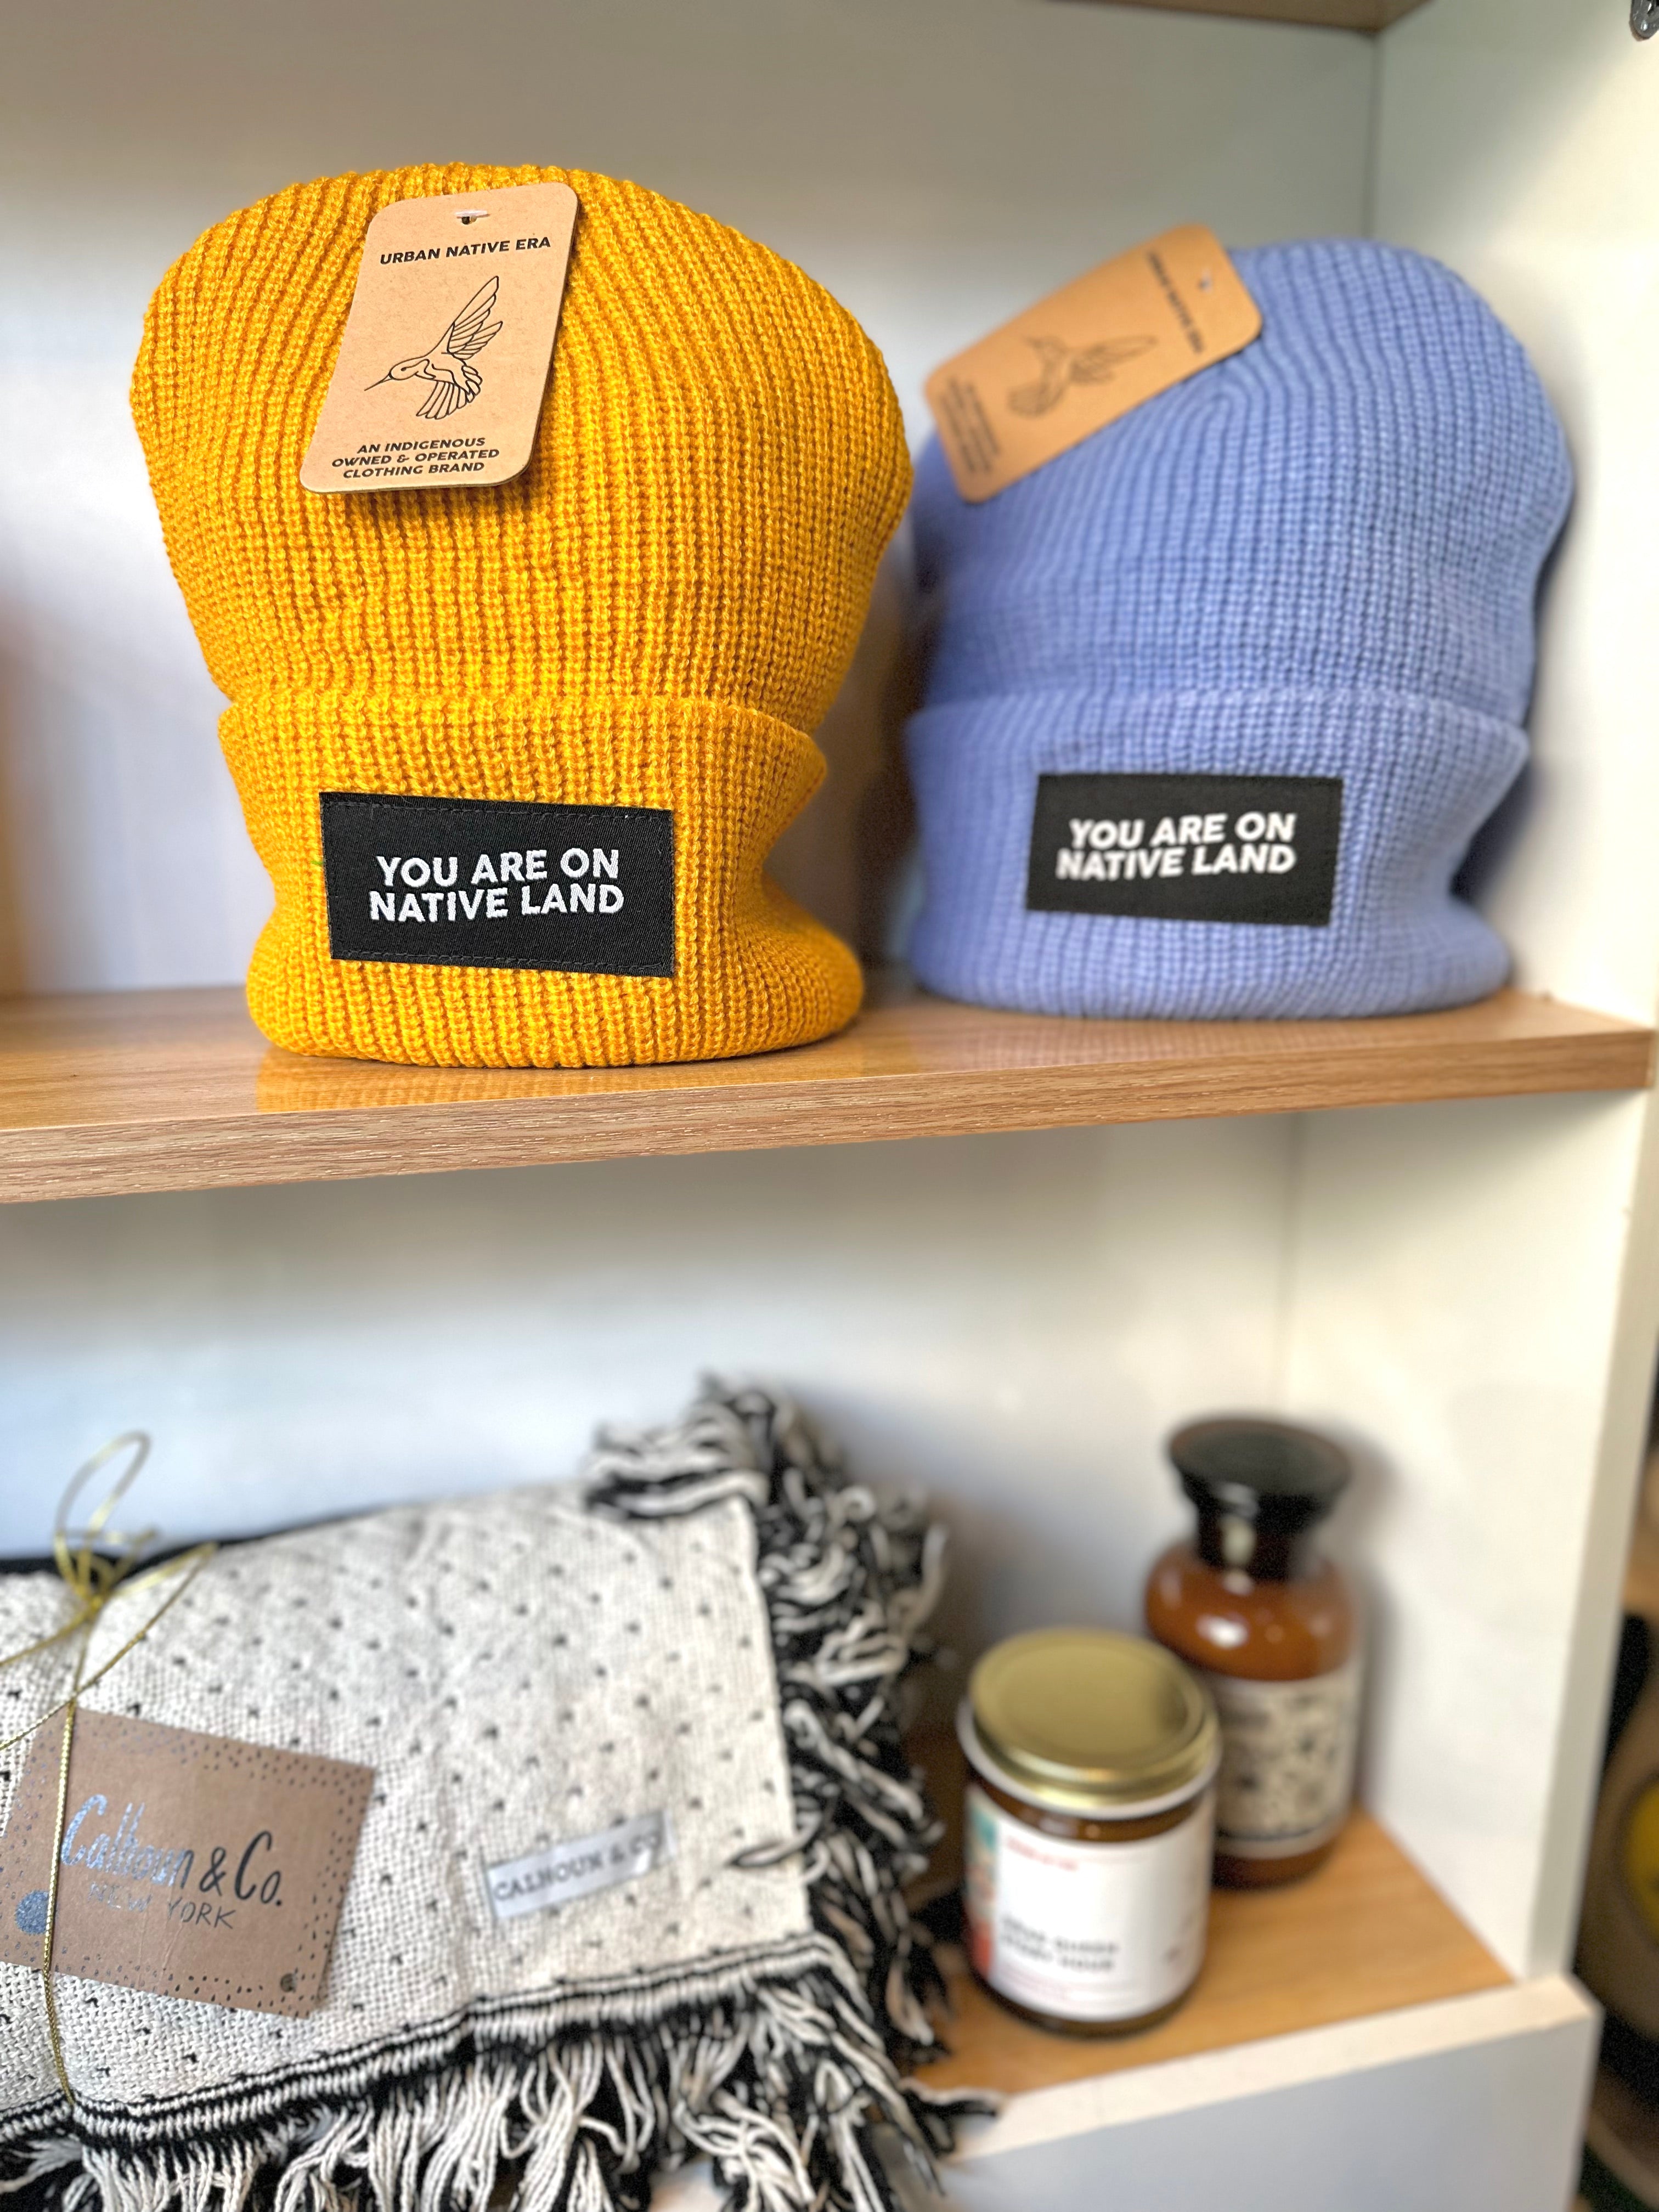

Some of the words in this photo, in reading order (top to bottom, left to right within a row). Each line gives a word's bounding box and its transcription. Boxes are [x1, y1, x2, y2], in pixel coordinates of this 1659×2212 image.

[380, 248, 441, 264] URBAN
[446, 240, 510, 257] NATIVE
[516, 236, 551, 250] ERA
[332, 455, 392, 467] OWNED
[397, 454, 410, 463] &
[415, 449, 500, 461] OPERATED
[357, 443, 381, 454] AN
[385, 438, 486, 452] INDIGENOUS
[343, 465, 423, 478] CLOTHING
[428, 462, 485, 473] BRAND
[1069, 818, 1144, 849] YOU
[1150, 813, 1228, 847] ARE
[1235, 812, 1296, 842] ON
[376, 855, 458, 888] YOU
[471, 849, 548, 883] ARE
[560, 848, 619, 879] ON
[1056, 846, 1186, 881] NATIVE
[1192, 843, 1296, 875] LAND
[369, 887, 509, 923] NATIVE
[521, 883, 624, 915] LAND
[61, 1794, 194, 1889] Calhoun
[199, 1847, 227, 1897] &
[234, 1830, 283, 1906] Co.
[88, 1882, 153, 1913] NEW
[167, 1897, 236, 1930] YORK
